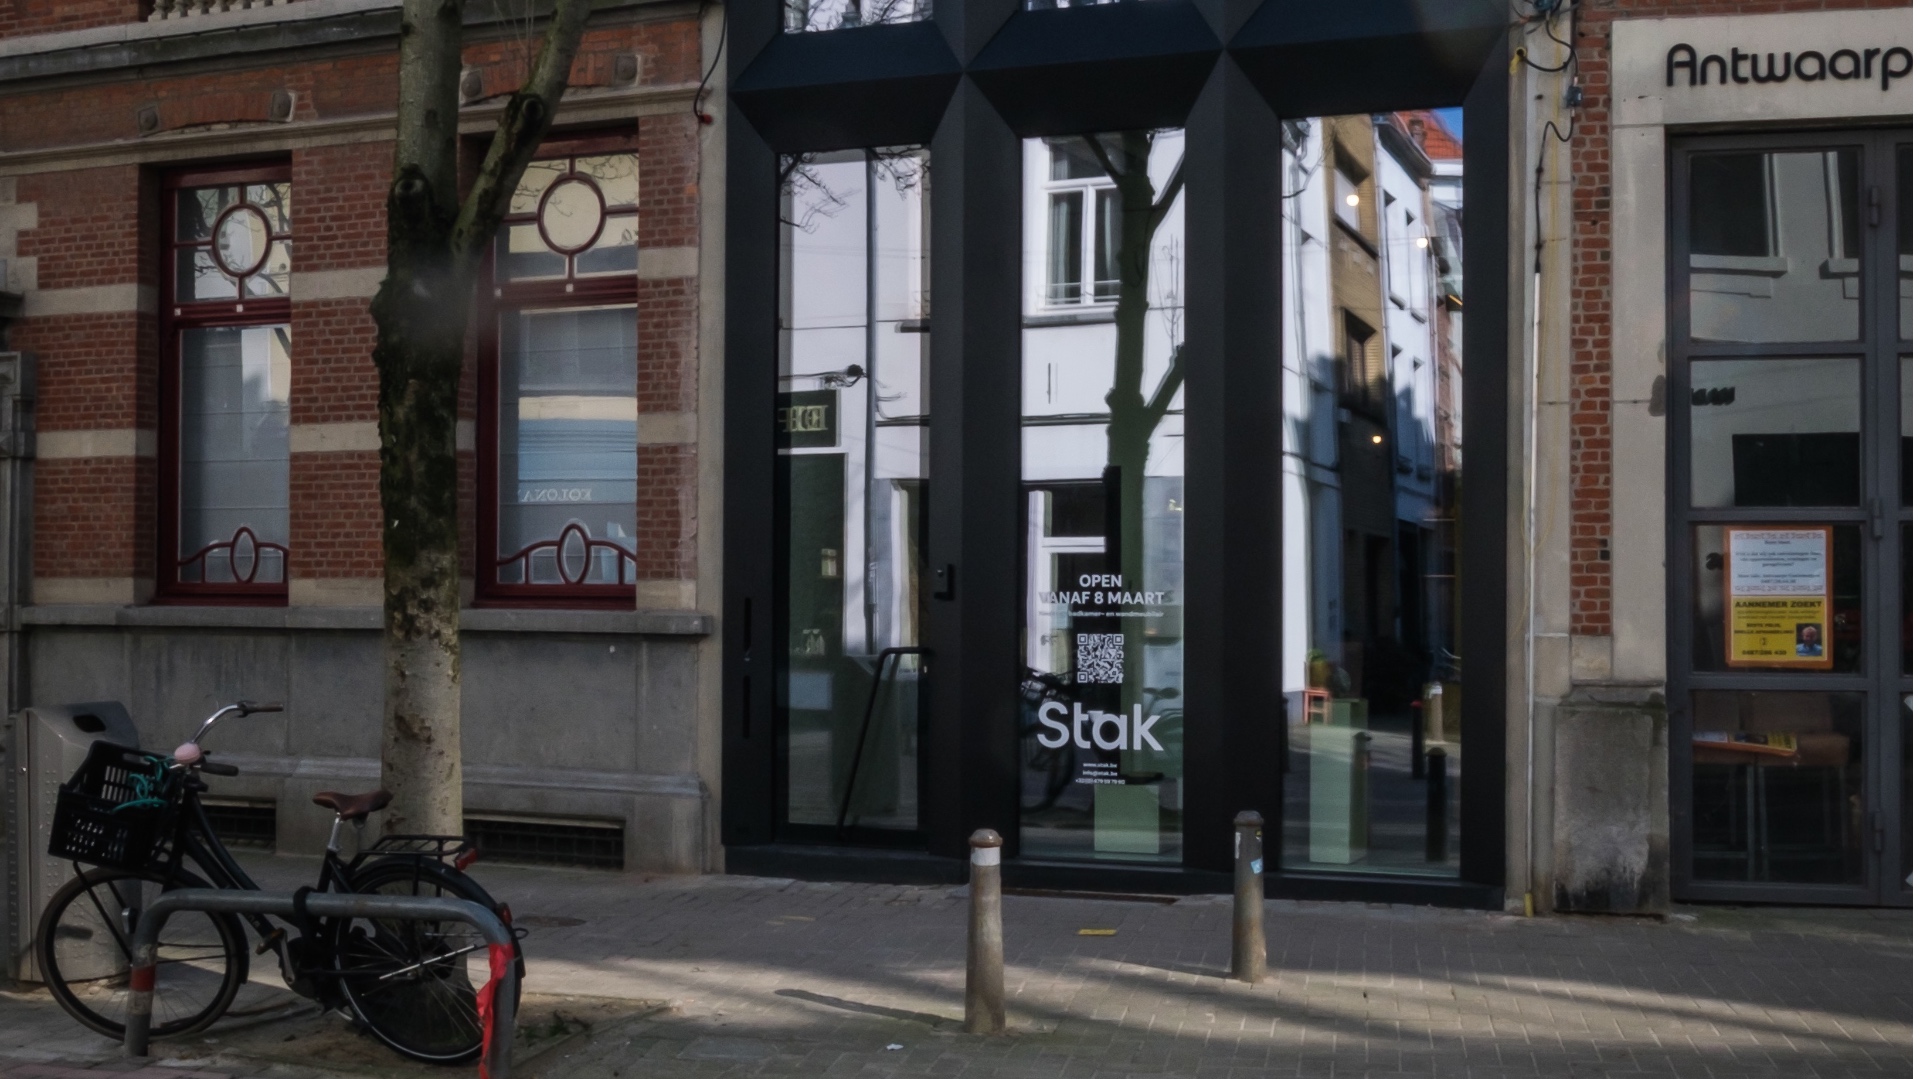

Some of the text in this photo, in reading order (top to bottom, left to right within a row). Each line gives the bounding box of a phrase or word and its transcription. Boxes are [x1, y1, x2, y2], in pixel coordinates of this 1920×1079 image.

[1666, 42, 1914, 91] Antwaarp
[1079, 574, 1122, 588] OPEN
[1038, 591, 1165, 605] VANAF 8 MAART
[1037, 701, 1164, 751] Stak
